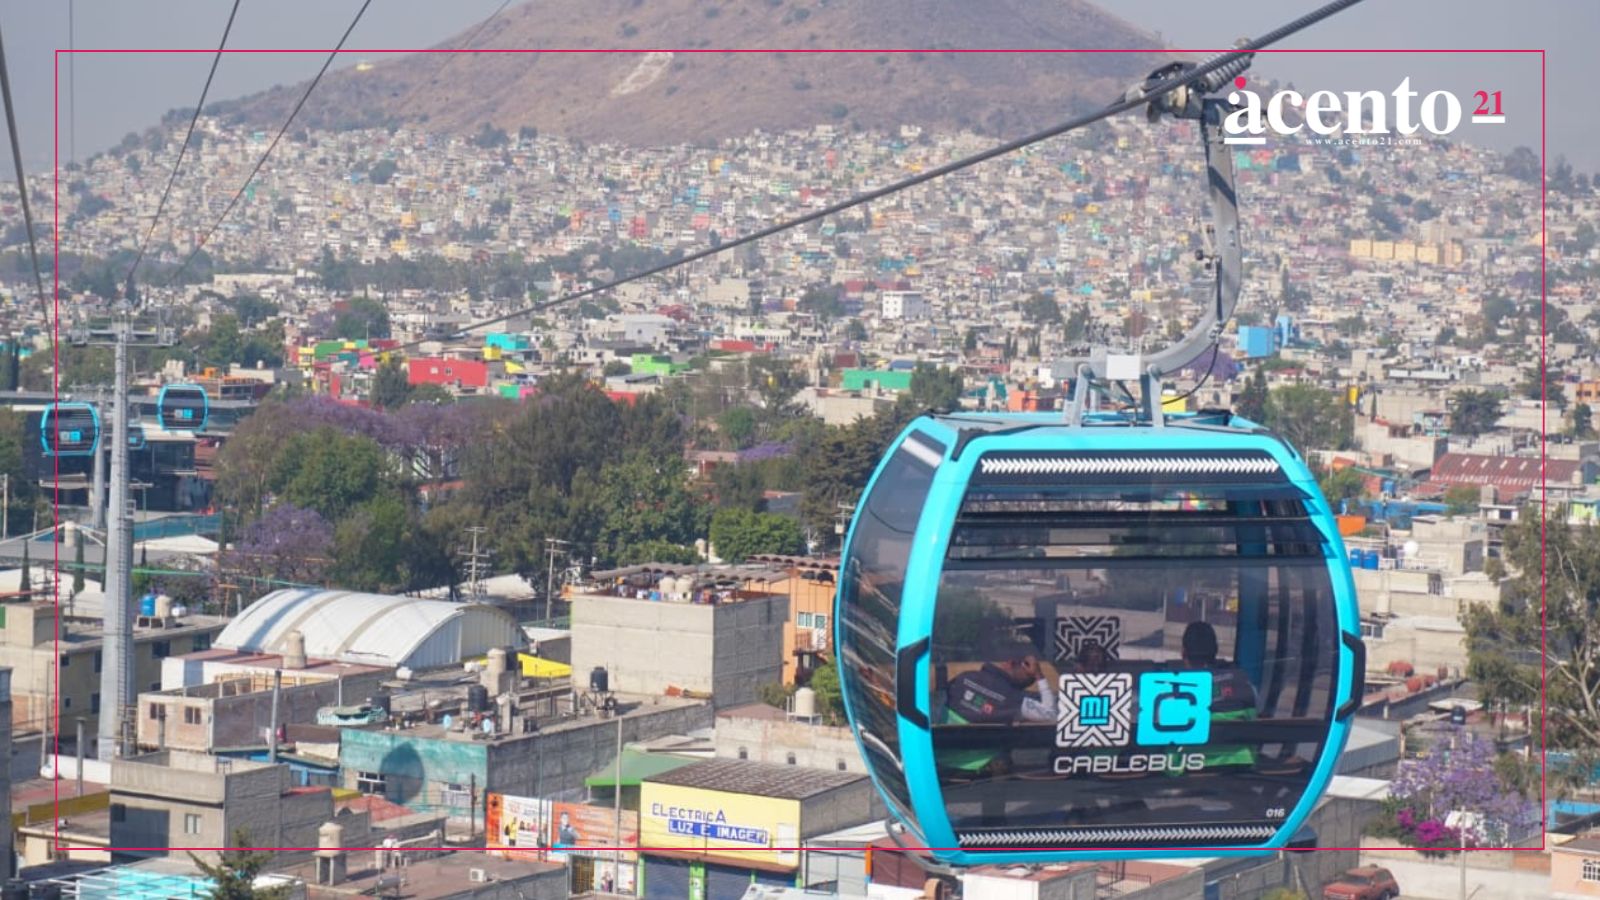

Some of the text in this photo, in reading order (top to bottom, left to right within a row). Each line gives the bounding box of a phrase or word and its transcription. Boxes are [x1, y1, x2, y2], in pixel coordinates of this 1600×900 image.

[1053, 746, 1206, 774] CABLEBÚS
[652, 802, 727, 824] ELECTRICA
[1265, 807, 1286, 818] 016
[669, 820, 767, 844] LUZ E IMAGEN
